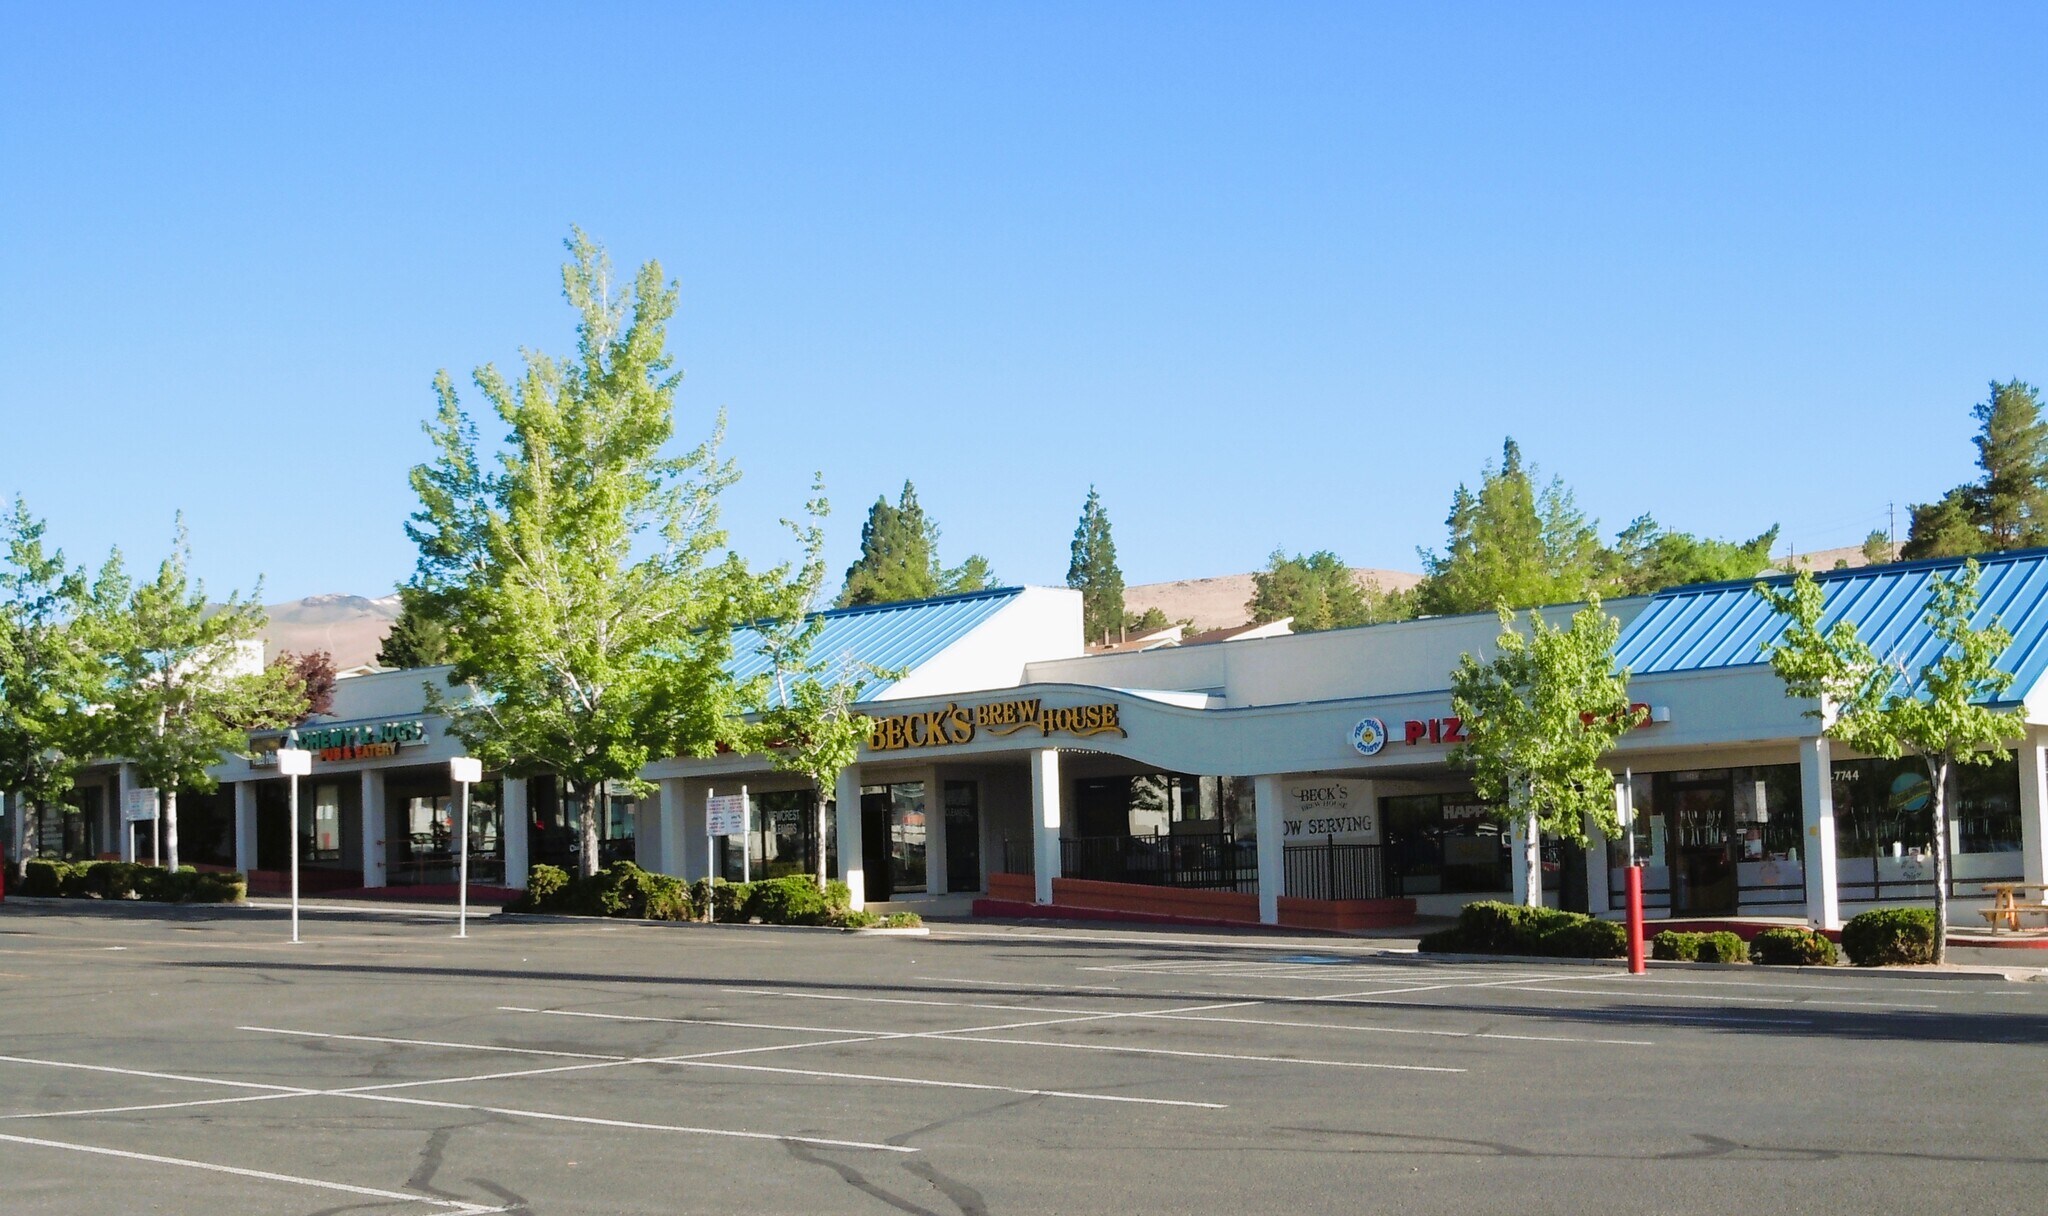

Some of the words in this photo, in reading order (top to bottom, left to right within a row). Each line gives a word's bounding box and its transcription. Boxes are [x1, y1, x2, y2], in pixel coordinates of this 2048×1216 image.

[300, 727, 358, 751] CHEWY
[359, 723, 373, 744] &
[376, 721, 424, 744] JUGS
[867, 703, 975, 751] BECK'S
[975, 699, 1041, 727] BREW
[1039, 703, 1120, 738] HOUSE
[1404, 716, 1478, 746] PIZ
[320, 748, 341, 762] PUB
[355, 742, 397, 761] EATERY
[1299, 783, 1348, 802] BECK'S
[1308, 815, 1372, 835] SERVING
